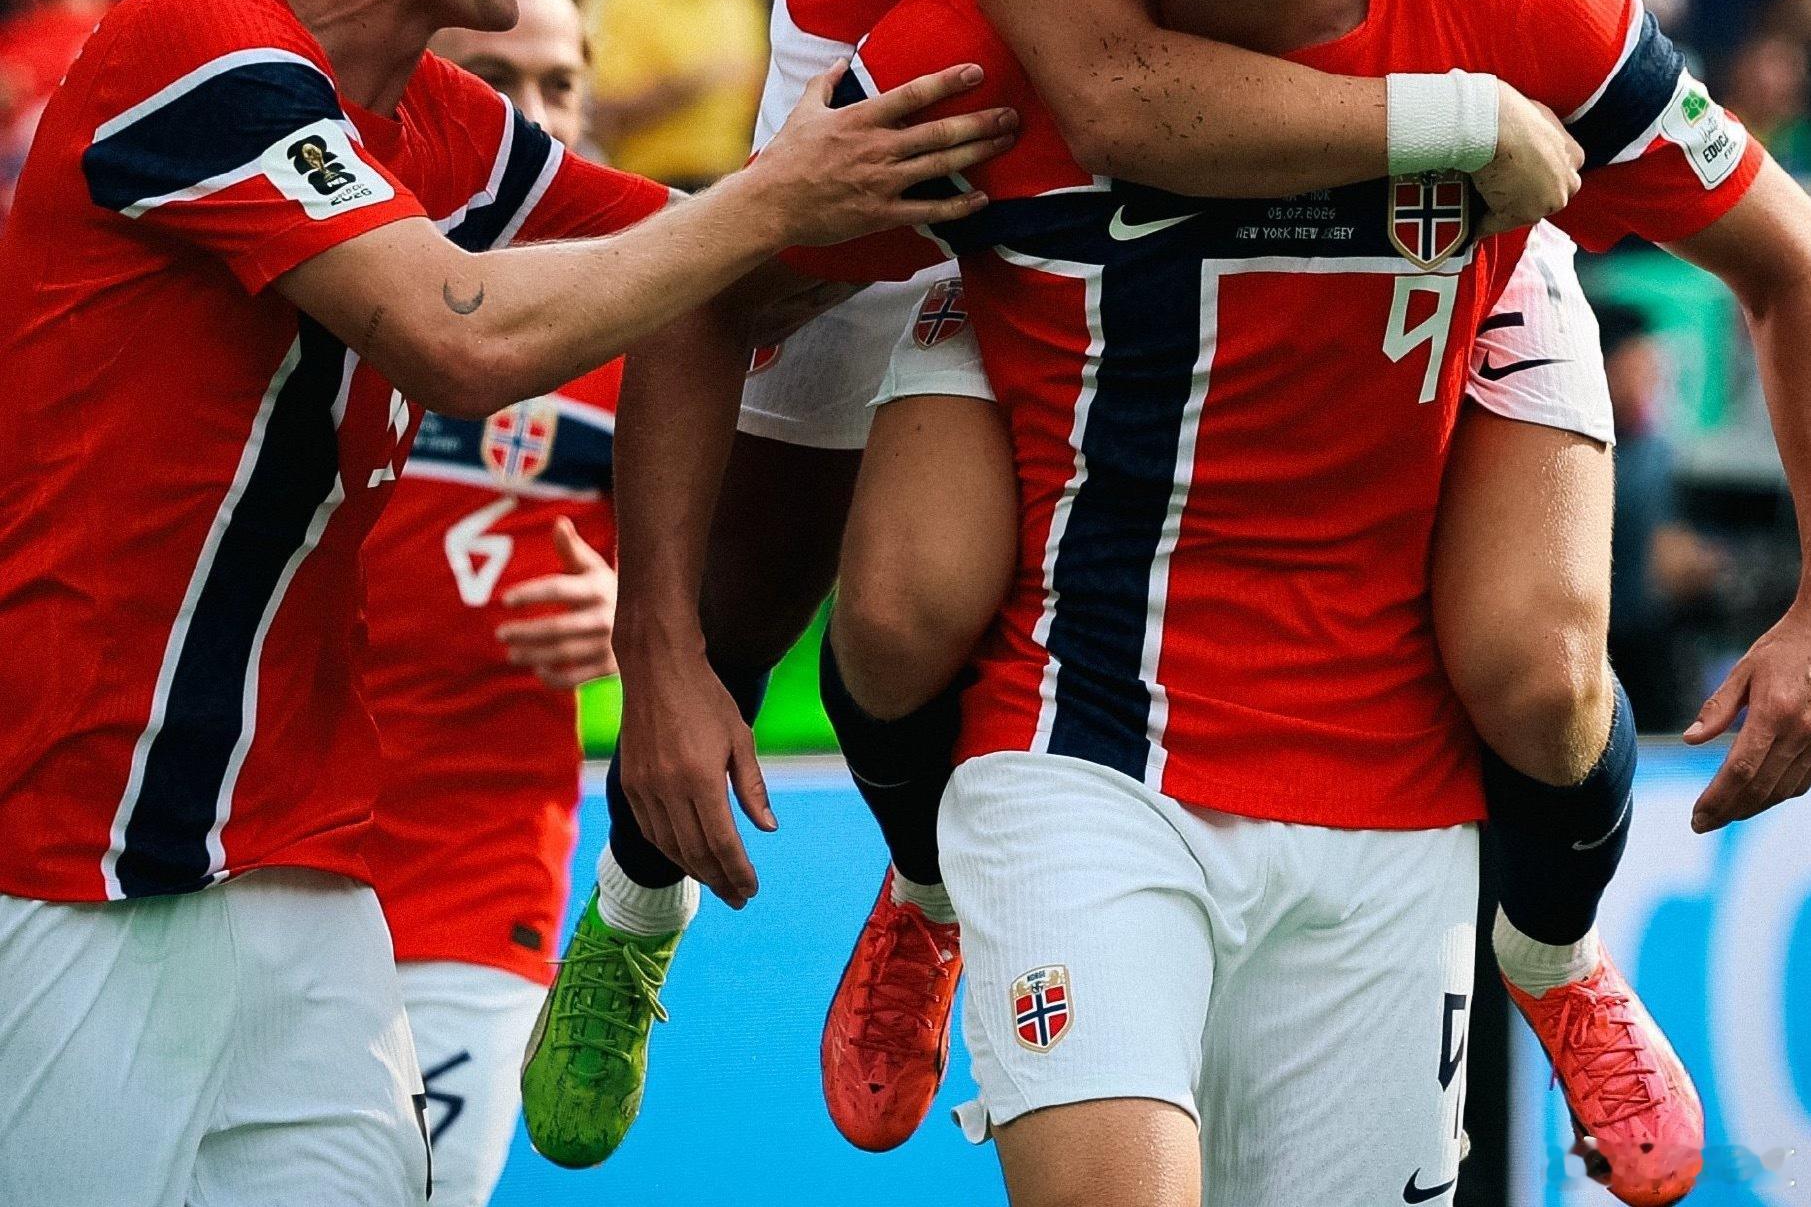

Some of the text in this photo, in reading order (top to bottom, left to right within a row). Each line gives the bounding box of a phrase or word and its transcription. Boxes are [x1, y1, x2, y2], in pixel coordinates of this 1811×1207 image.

[1236, 227, 1259, 239] NEW
[1263, 227, 1292, 239] YORK
[1295, 227, 1319, 239] NEW
[1268, 207, 1337, 220] 05.07.2026
[1383, 275, 1459, 404] 9
[444, 493, 518, 607] 6
